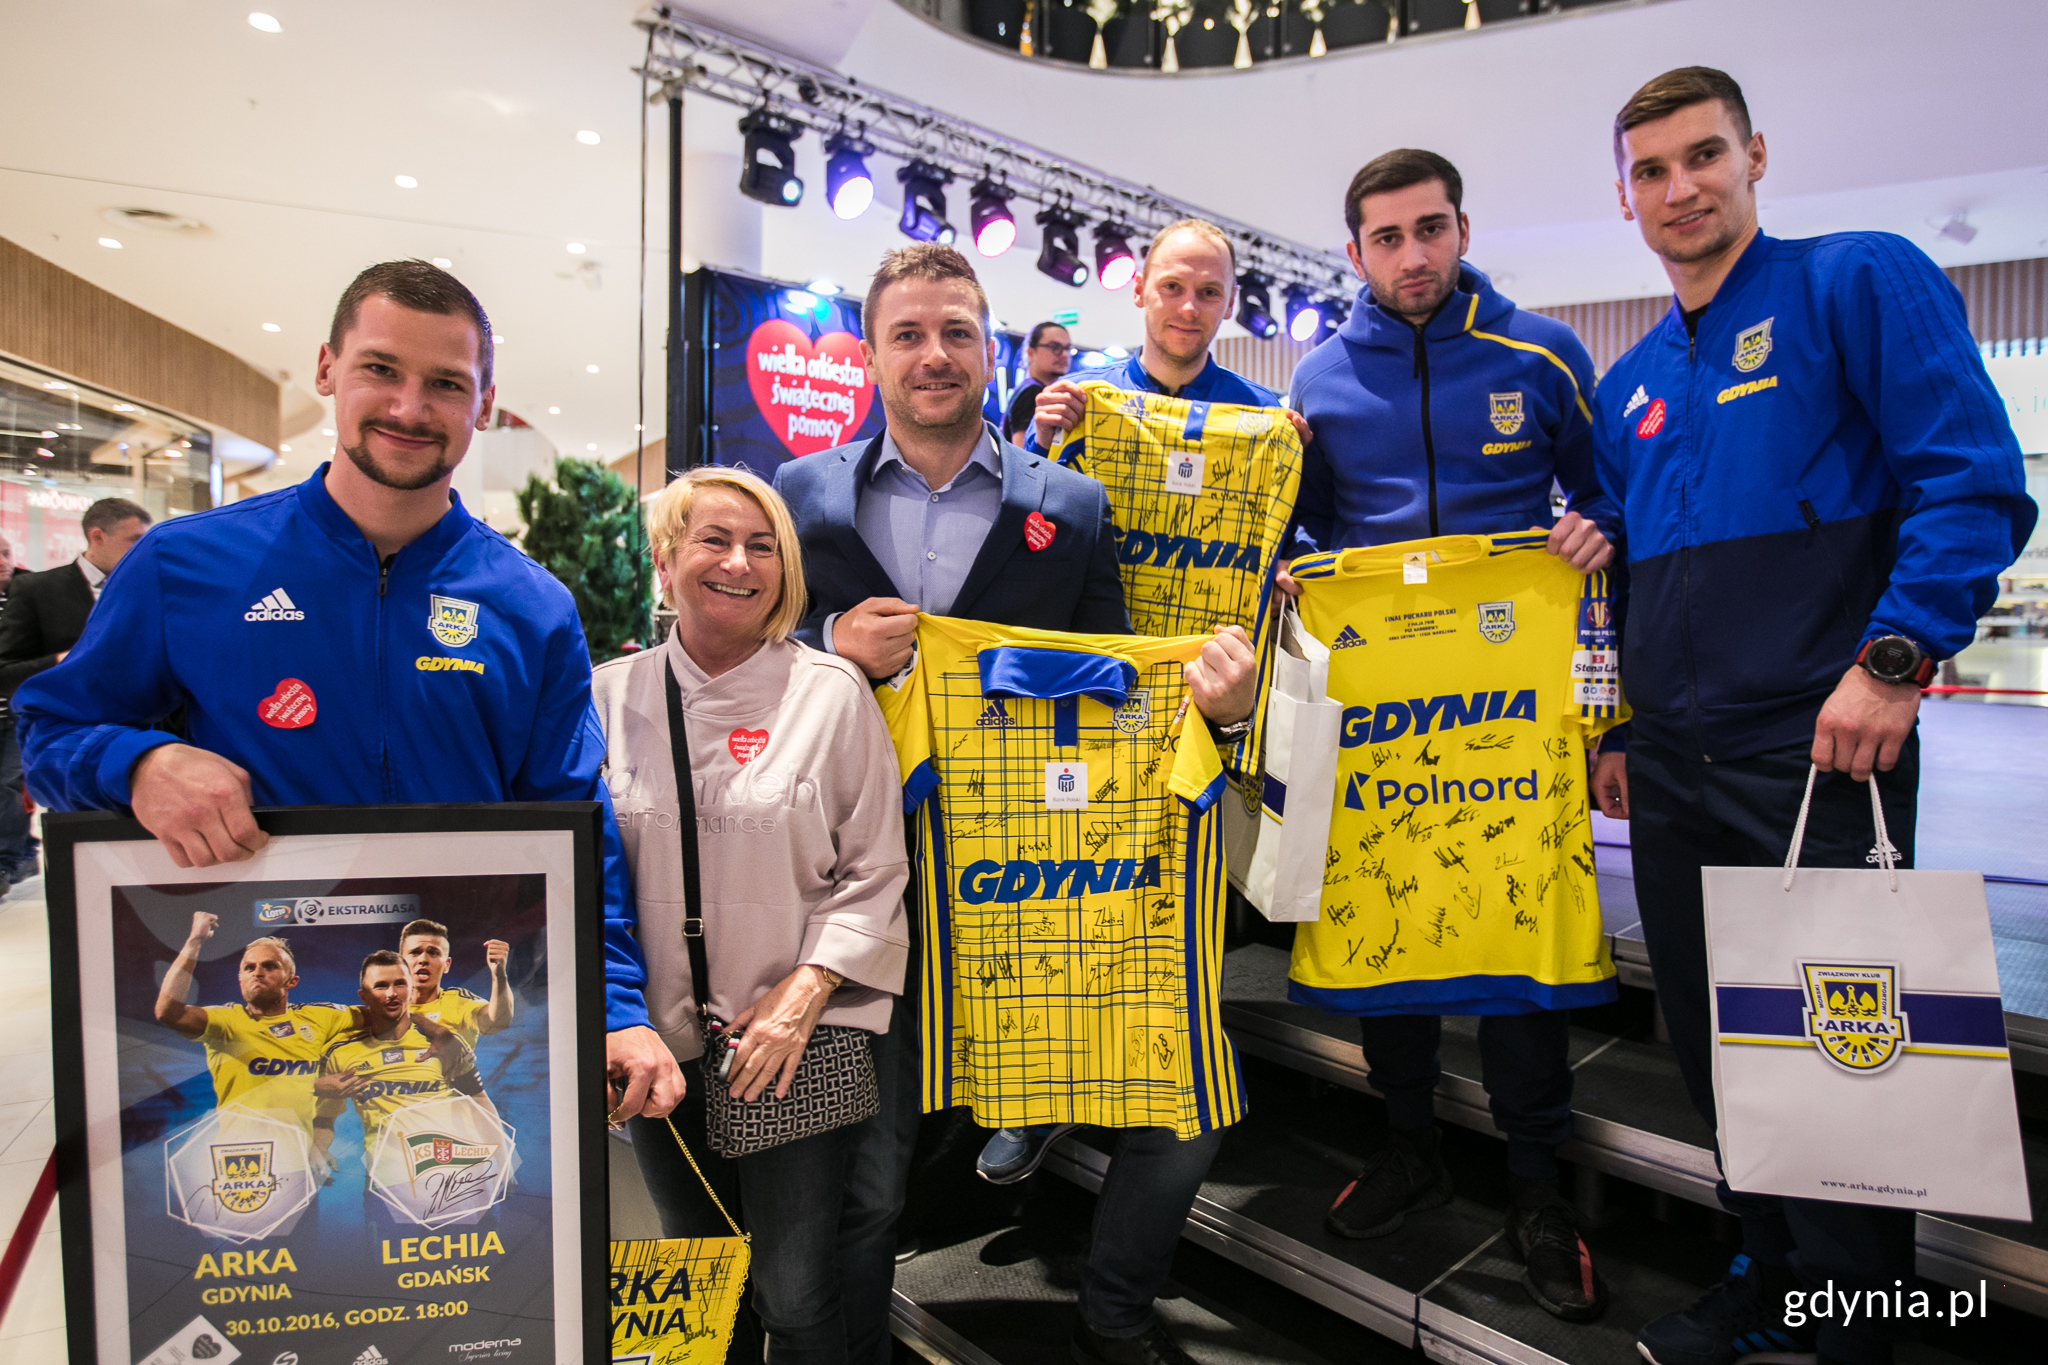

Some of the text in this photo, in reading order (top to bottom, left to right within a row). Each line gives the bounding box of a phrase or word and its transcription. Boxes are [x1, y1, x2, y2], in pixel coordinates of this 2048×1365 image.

[757, 343, 865, 388] wielka orkiestra
[1716, 375, 1778, 404] GDYNIA
[770, 375, 855, 426] świątecznej
[788, 413, 843, 448] pomocy
[1482, 440, 1532, 455] GDYNIA
[244, 608, 305, 622] adidas
[1434, 608, 1456, 617] POLSKI
[437, 621, 469, 633] ARKA
[415, 655, 485, 675] GDYNIA
[1574, 663, 1604, 673] Stena
[975, 716, 1016, 727] adidas
[1339, 689, 1536, 749] GDYNIA
[1376, 769, 1539, 810] Polnord
[958, 854, 1162, 905] GDYNIA
[328, 903, 417, 916] EKSTRAKLASA
[1824, 1020, 1890, 1034] ARKA
[360, 1080, 440, 1104] DYNIA
[413, 1145, 432, 1161] KS
[454, 1146, 490, 1156] LECHIA
[222, 1180, 267, 1190] ARKA
[1820, 1180, 1928, 1197] www.arka.gdynia.pl
[381, 1231, 505, 1265] LECHIA
[194, 1247, 298, 1280] ARKA
[397, 1265, 490, 1290] GDAŃSK
[202, 1282, 292, 1306] GDYNIA
[225, 1300, 469, 1337] 30.10.2016, GODZ. 18:00
[449, 1338, 522, 1353] moderna
